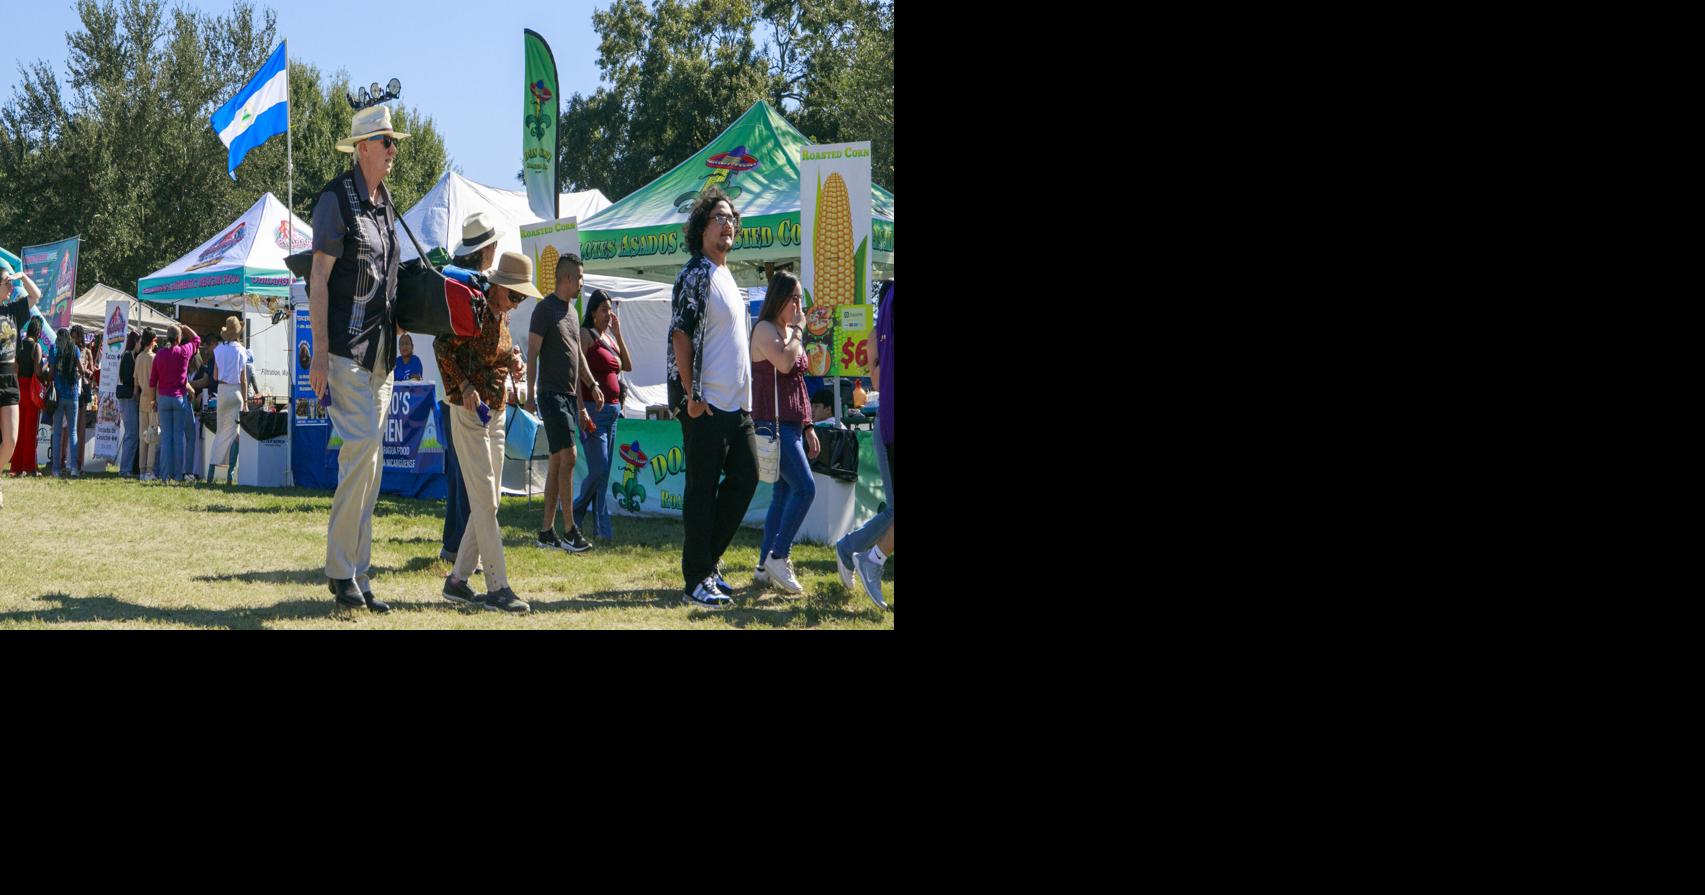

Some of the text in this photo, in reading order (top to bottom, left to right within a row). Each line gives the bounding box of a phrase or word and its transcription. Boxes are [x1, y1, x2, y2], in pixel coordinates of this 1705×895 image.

[802, 146, 870, 160] ROASTED CORN
[520, 223, 577, 239] ROASTED CORN
[736, 218, 801, 250] STED CO
[618, 232, 678, 258] ASADOS
[841, 337, 868, 370] $6
[397, 447, 410, 456] FOOD
